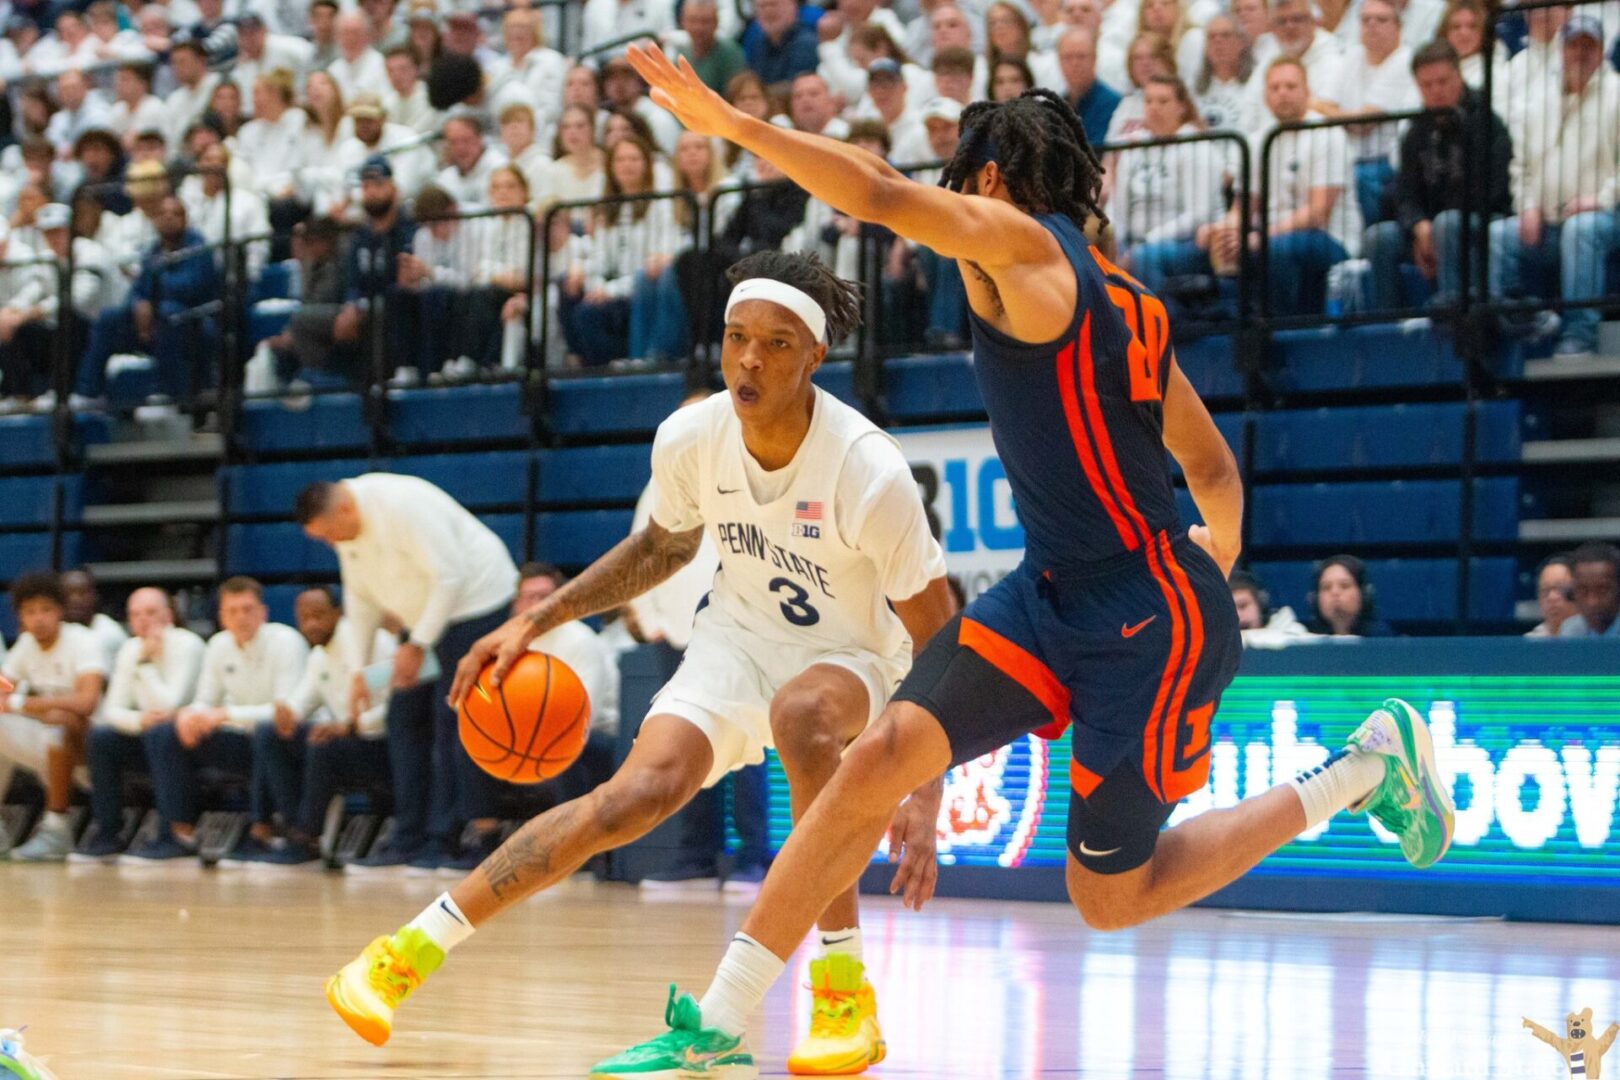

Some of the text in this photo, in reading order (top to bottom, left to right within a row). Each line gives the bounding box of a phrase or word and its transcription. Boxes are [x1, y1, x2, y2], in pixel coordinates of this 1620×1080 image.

[718, 521, 837, 600] PENN STATE
[768, 576, 821, 627] 3
[1166, 700, 1332, 843] ub
